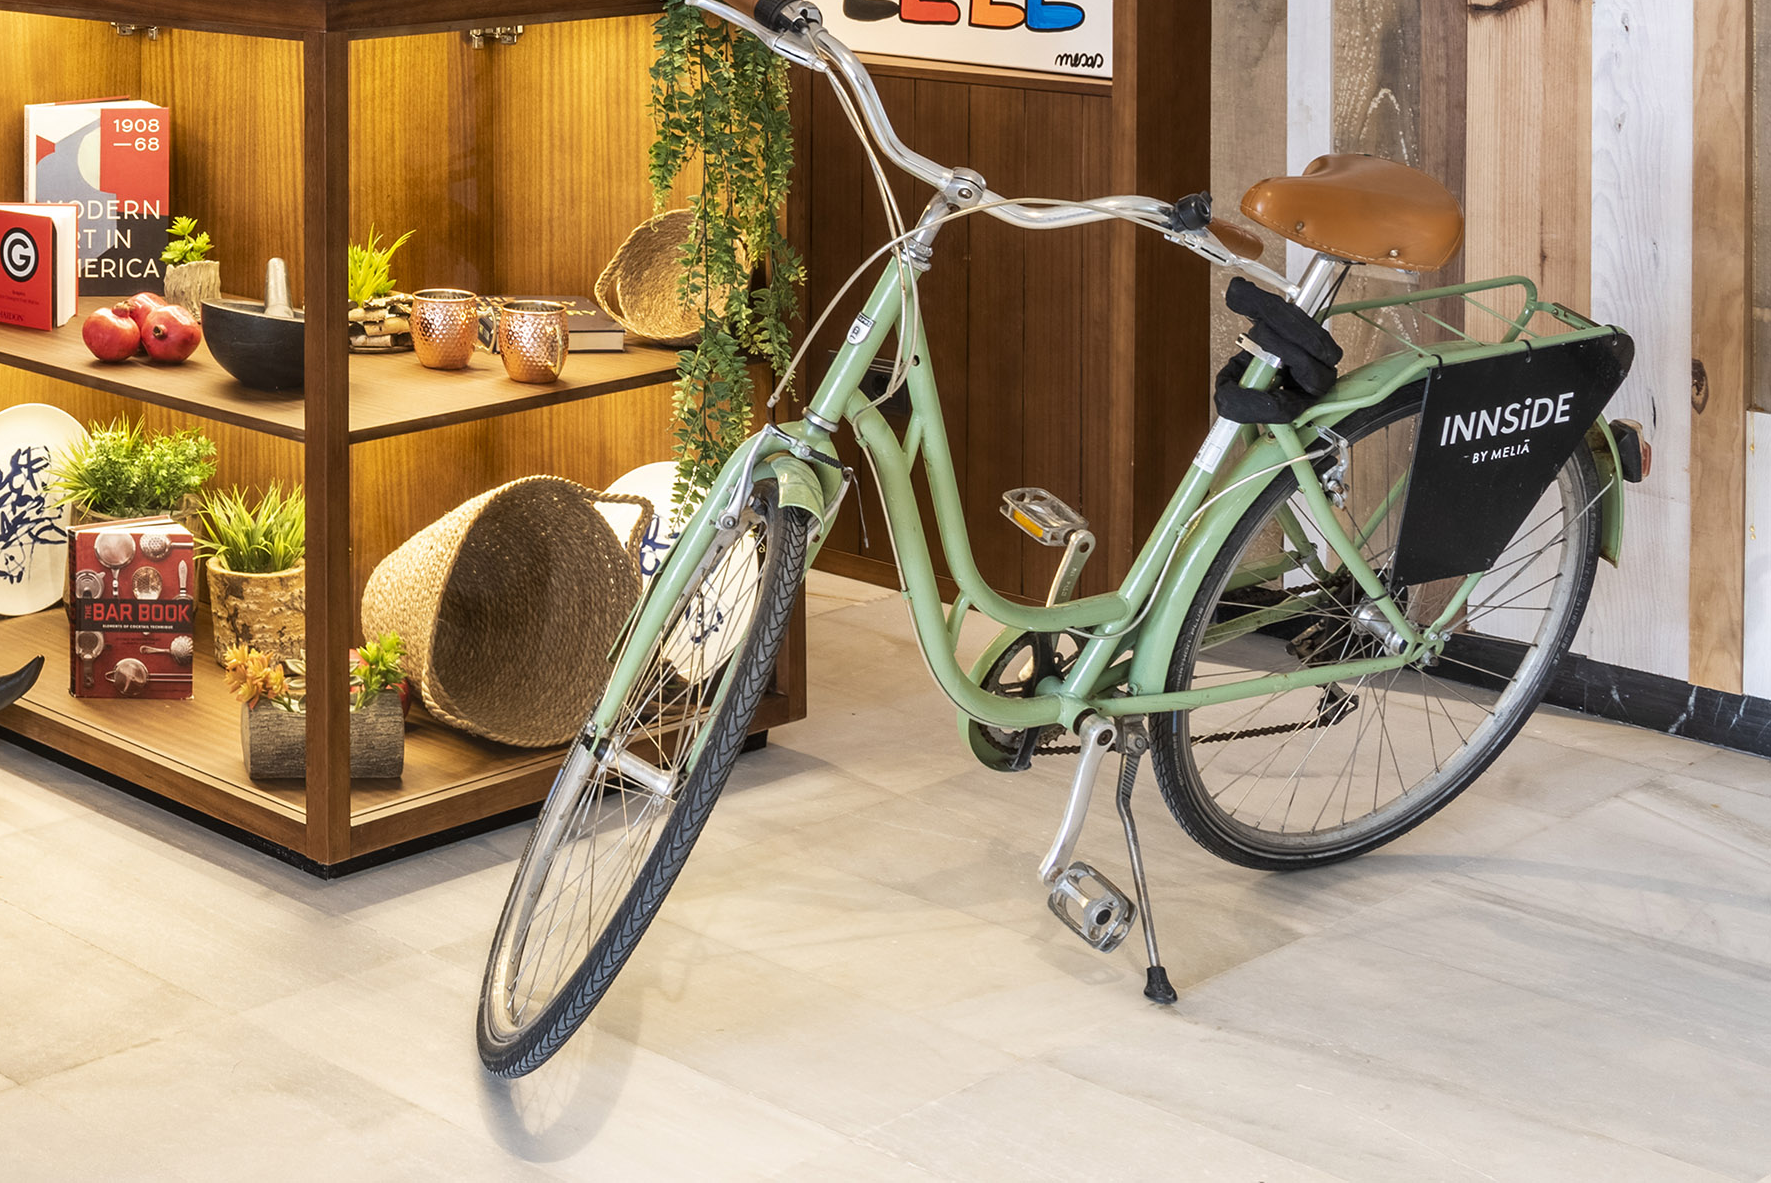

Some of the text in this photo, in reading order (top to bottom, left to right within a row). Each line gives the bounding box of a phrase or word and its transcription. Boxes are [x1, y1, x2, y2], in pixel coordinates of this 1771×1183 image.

[113, 118, 160, 133] 1908
[106, 229, 131, 249] IN
[1472, 450, 1489, 464] BY
[93, 603, 133, 622] BAR
[138, 604, 191, 623] BOOK
